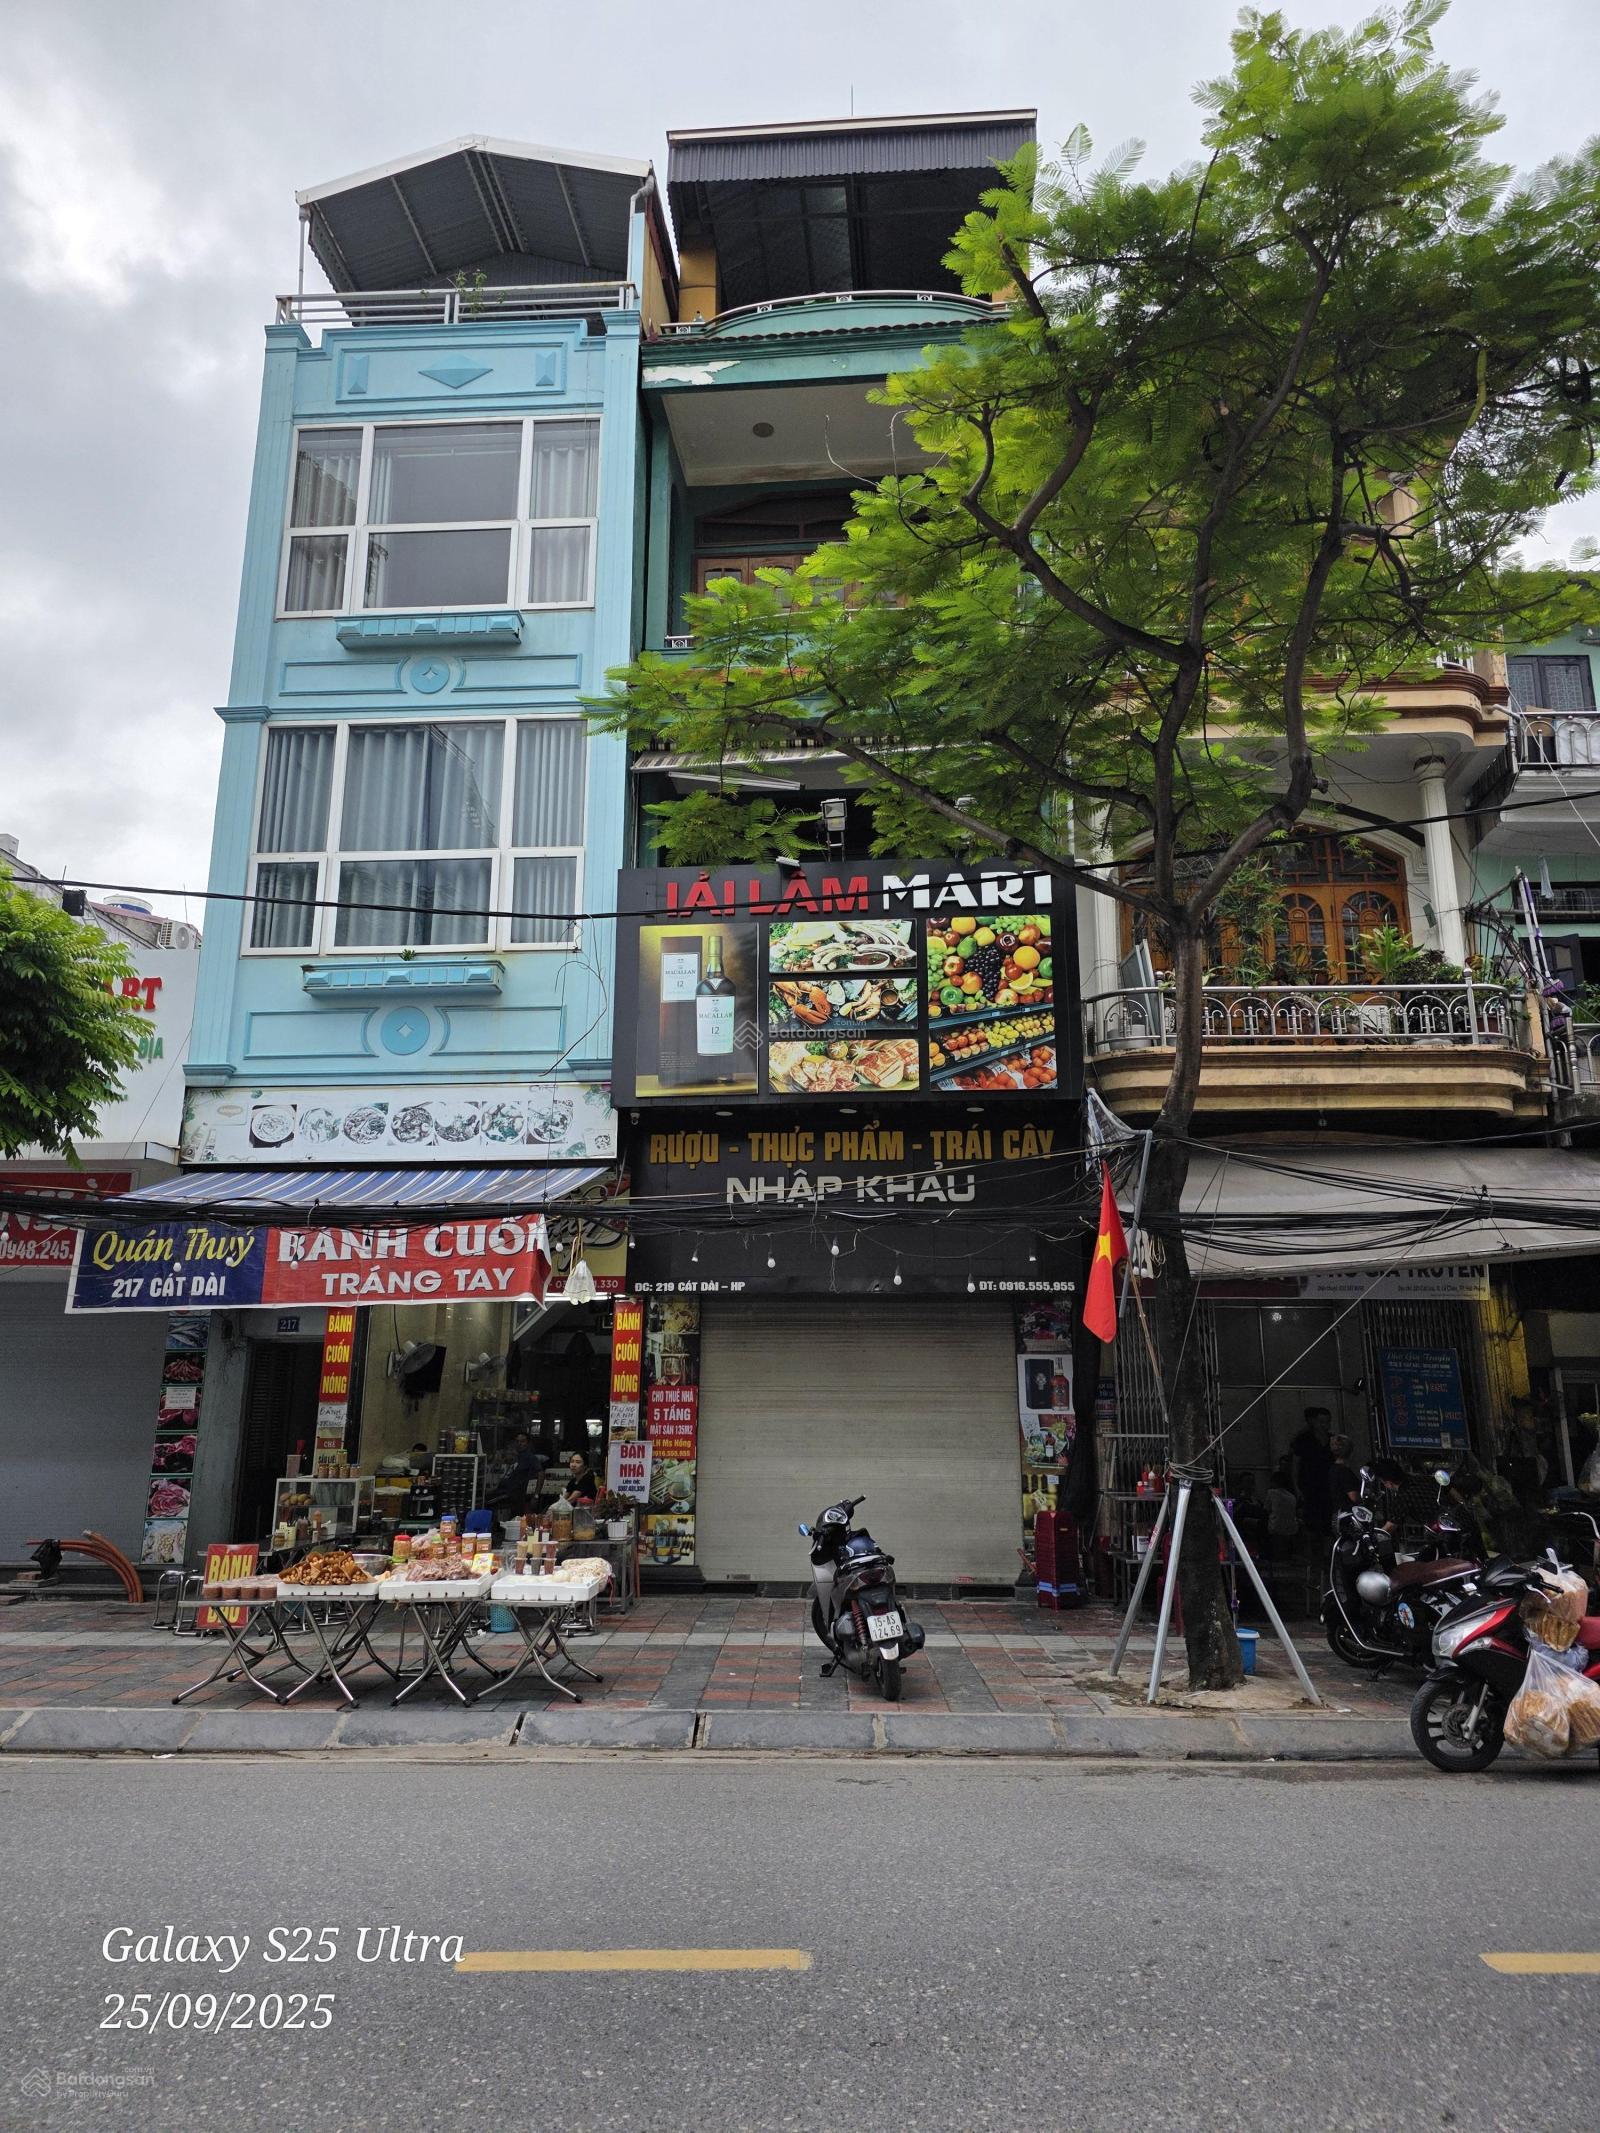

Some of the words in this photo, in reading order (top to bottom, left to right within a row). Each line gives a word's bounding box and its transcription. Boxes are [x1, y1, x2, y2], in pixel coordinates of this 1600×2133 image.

[750, 869, 870, 915] LÂM
[882, 870, 1053, 911] MART
[711, 1026, 720, 1035] 12
[650, 1131, 719, 1169] RƯỢU
[748, 1126, 815, 1168] THỰC
[824, 1120, 904, 1162] PHẨM
[930, 1124, 992, 1161] TRÁI
[1003, 1123, 1054, 1160] CÂY
[726, 1169, 842, 1208] NHẬP
[93, 1230, 173, 1271] Quán
[112, 1278, 144, 1298] 217
[150, 1273, 187, 1297] CÁT
[321, 1265, 442, 1296] TRÁNG
[453, 1268, 515, 1292] TAY
[656, 1282, 675, 1292] 219
[678, 1280, 698, 1291] CÁT
[701, 1280, 719, 1291] DÀI
[731, 1282, 746, 1291] HP
[999, 1281, 1075, 1292] 0916.555.955
[280, 1319, 297, 1330] 217
[328, 1311, 352, 1333] BÁNH
[616, 1309, 641, 1331] BÁNH
[325, 1339, 351, 1363] CUỐN
[615, 1337, 639, 1361] CUỐN
[321, 1372, 347, 1394] NÓNG
[613, 1371, 638, 1393] NÓNG
[651, 1391, 664, 1402] CHO
[681, 1389, 694, 1402] NHÀ
[653, 1409, 661, 1420] 5
[619, 1461, 645, 1478] NHÀ
